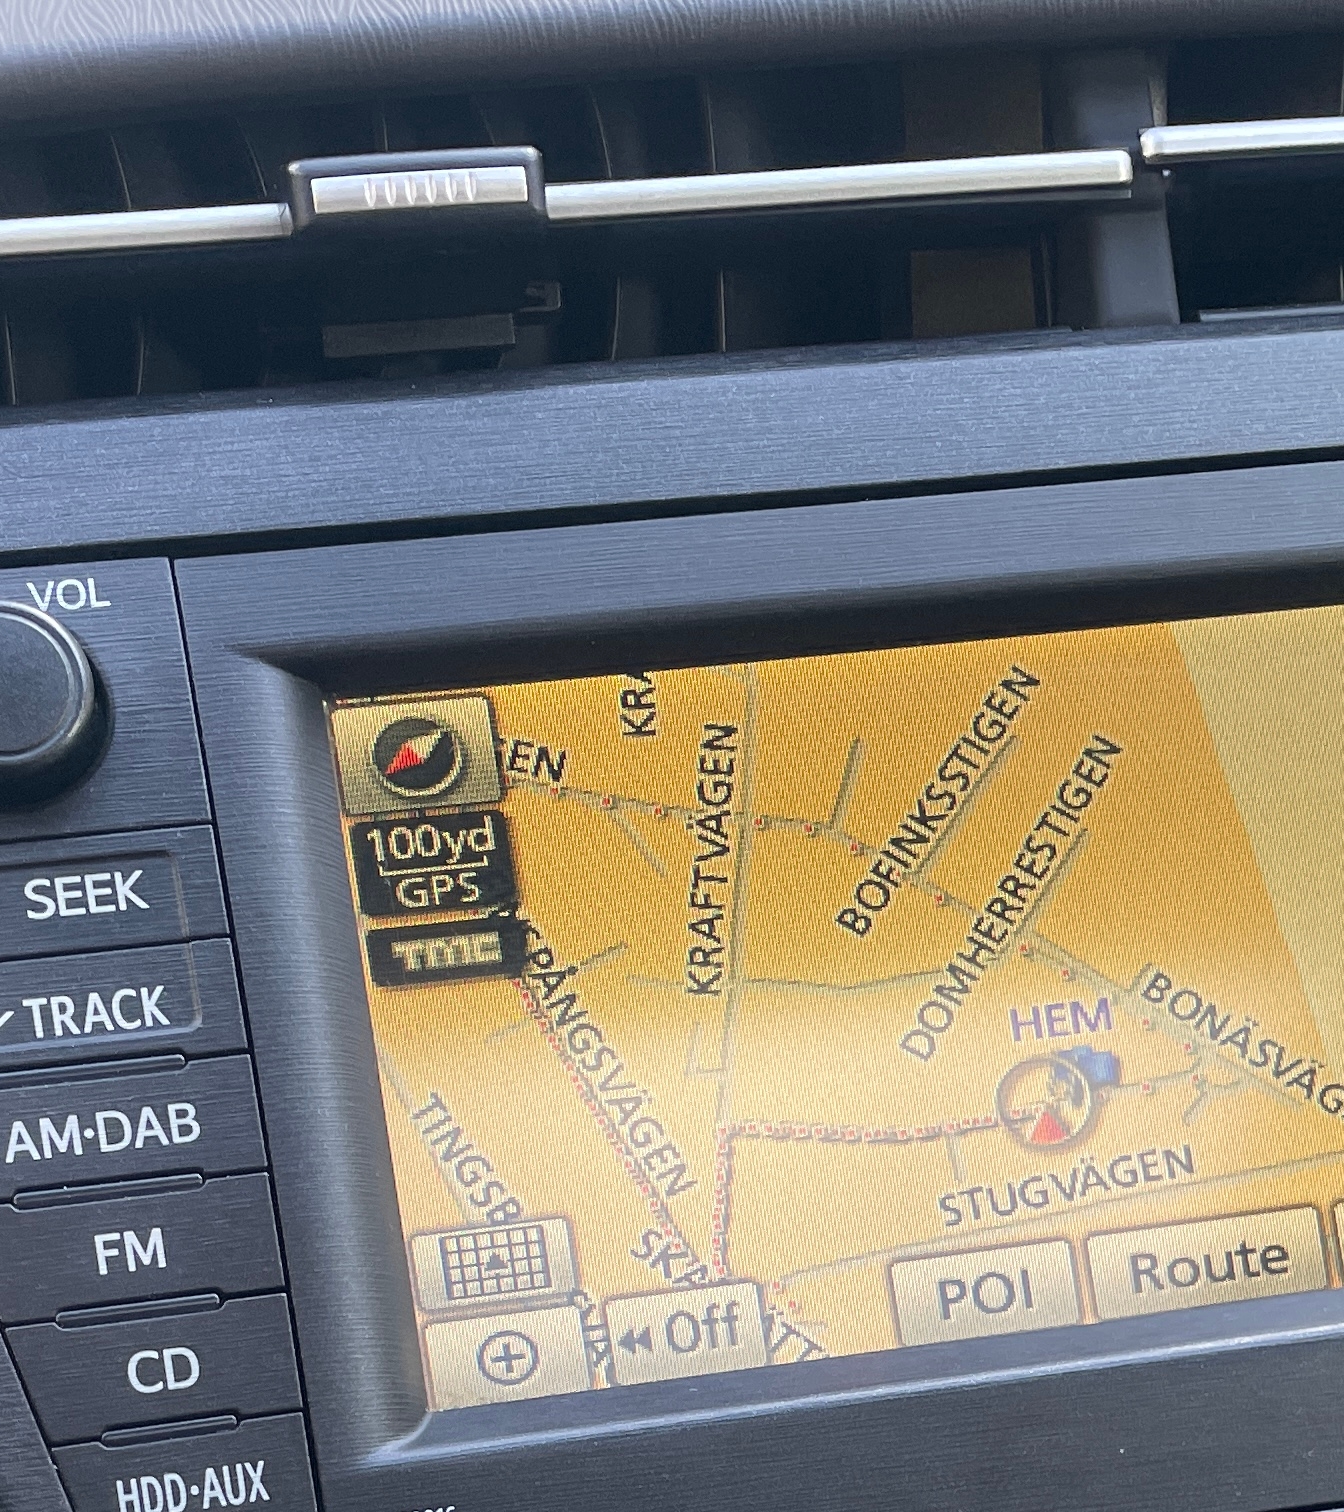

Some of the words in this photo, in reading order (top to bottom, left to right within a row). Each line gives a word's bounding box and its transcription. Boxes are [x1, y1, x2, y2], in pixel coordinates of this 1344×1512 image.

[25, 576, 112, 612] VOL
[835, 665, 1041, 938] BOFINKSSTIGEN
[367, 815, 497, 864] 100yd
[687, 723, 739, 996] KRAFTVÄGEN
[23, 869, 150, 920] SEEK
[396, 872, 481, 909] GPS
[901, 735, 1123, 1062] DOMHERRESTIGEN
[22, 985, 171, 1039] TRACK
[1010, 998, 1114, 1041] HEM
[938, 1144, 1195, 1226] STUGVÄGEN
[93, 1227, 167, 1276] FM
[1129, 1240, 1289, 1295] Route
[937, 1267, 1035, 1320] POI
[665, 1300, 740, 1352] Off
[127, 1347, 200, 1394] CD
